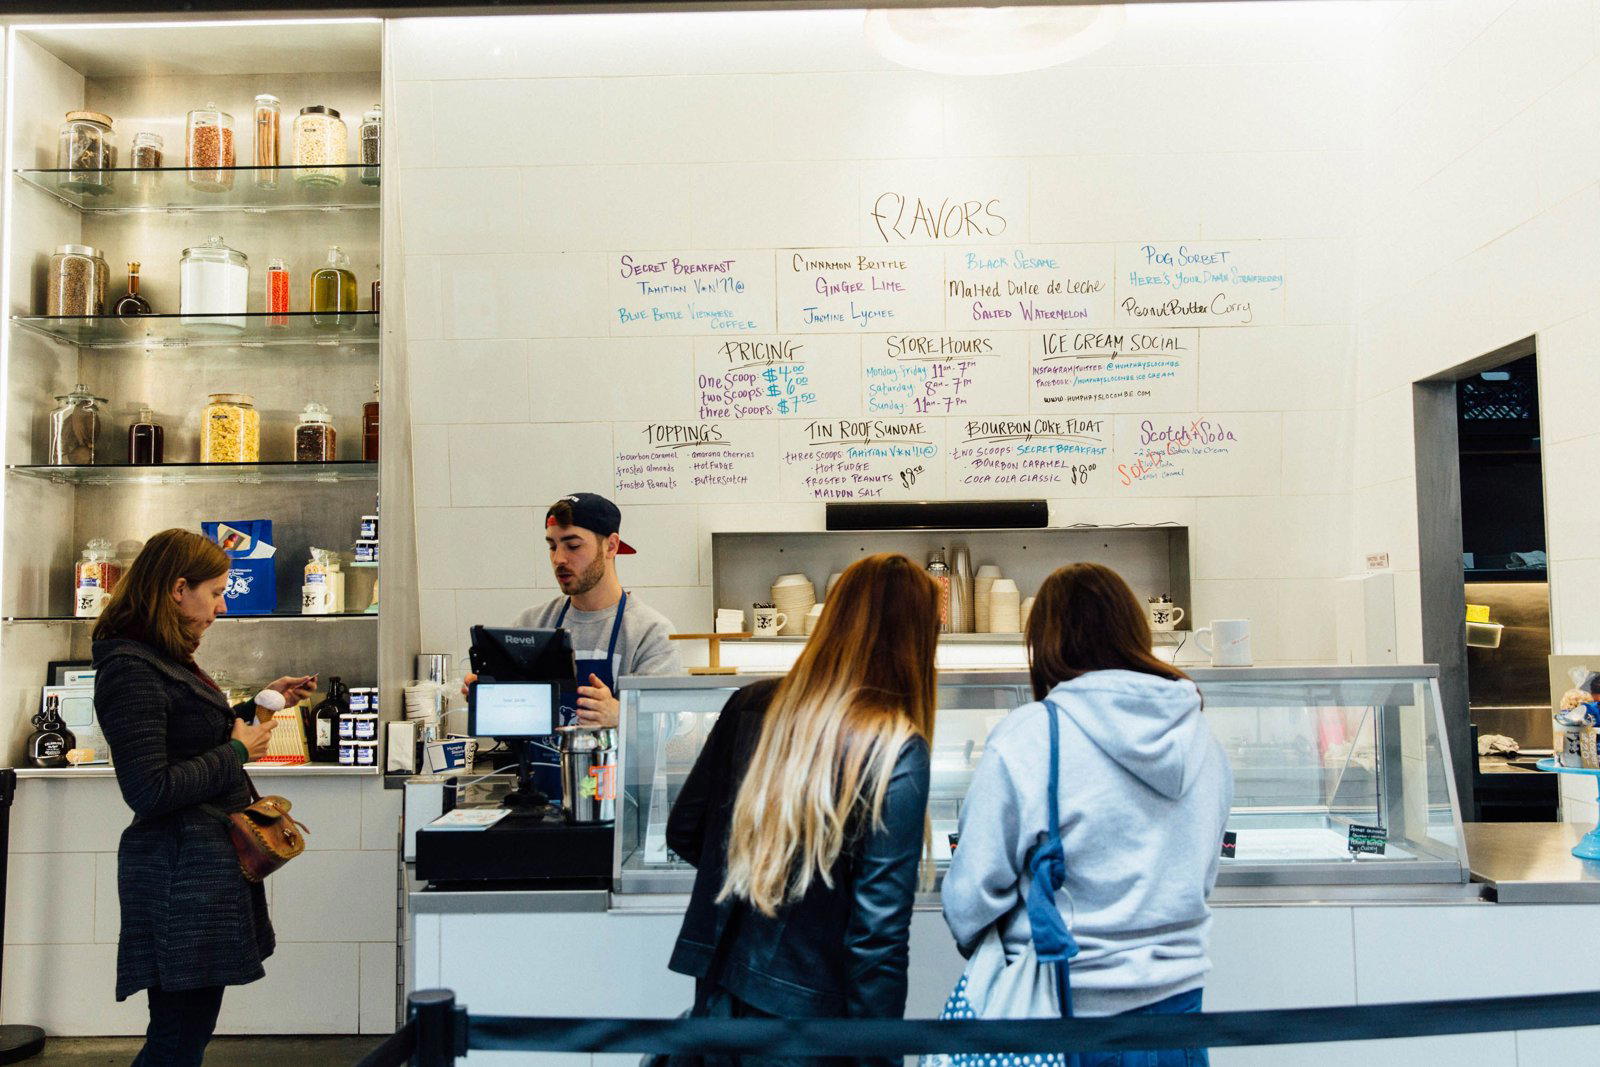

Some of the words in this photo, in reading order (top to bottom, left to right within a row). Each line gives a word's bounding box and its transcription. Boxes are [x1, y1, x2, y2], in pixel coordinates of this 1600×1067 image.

[672, 257, 736, 275] BREAKFAST
[793, 254, 851, 272] CINNAMON
[816, 277, 865, 297] GINGER
[872, 276, 906, 292] LIME
[1008, 280, 1040, 296] Dulce
[1047, 280, 1063, 294] de
[718, 340, 804, 363] PRICING
[887, 336, 937, 357] STORE
[941, 337, 993, 354] HOURS
[1043, 334, 1068, 355] ICE
[1074, 334, 1124, 351] CREAM
[642, 424, 723, 444] TOPPINGS
[804, 421, 833, 439] TIN
[840, 421, 873, 439] ROOF
[965, 421, 1031, 437] BOURBON
[1035, 420, 1064, 435] COKE
[1066, 419, 1104, 434] FLOAT
[505, 635, 535, 644] Revel
